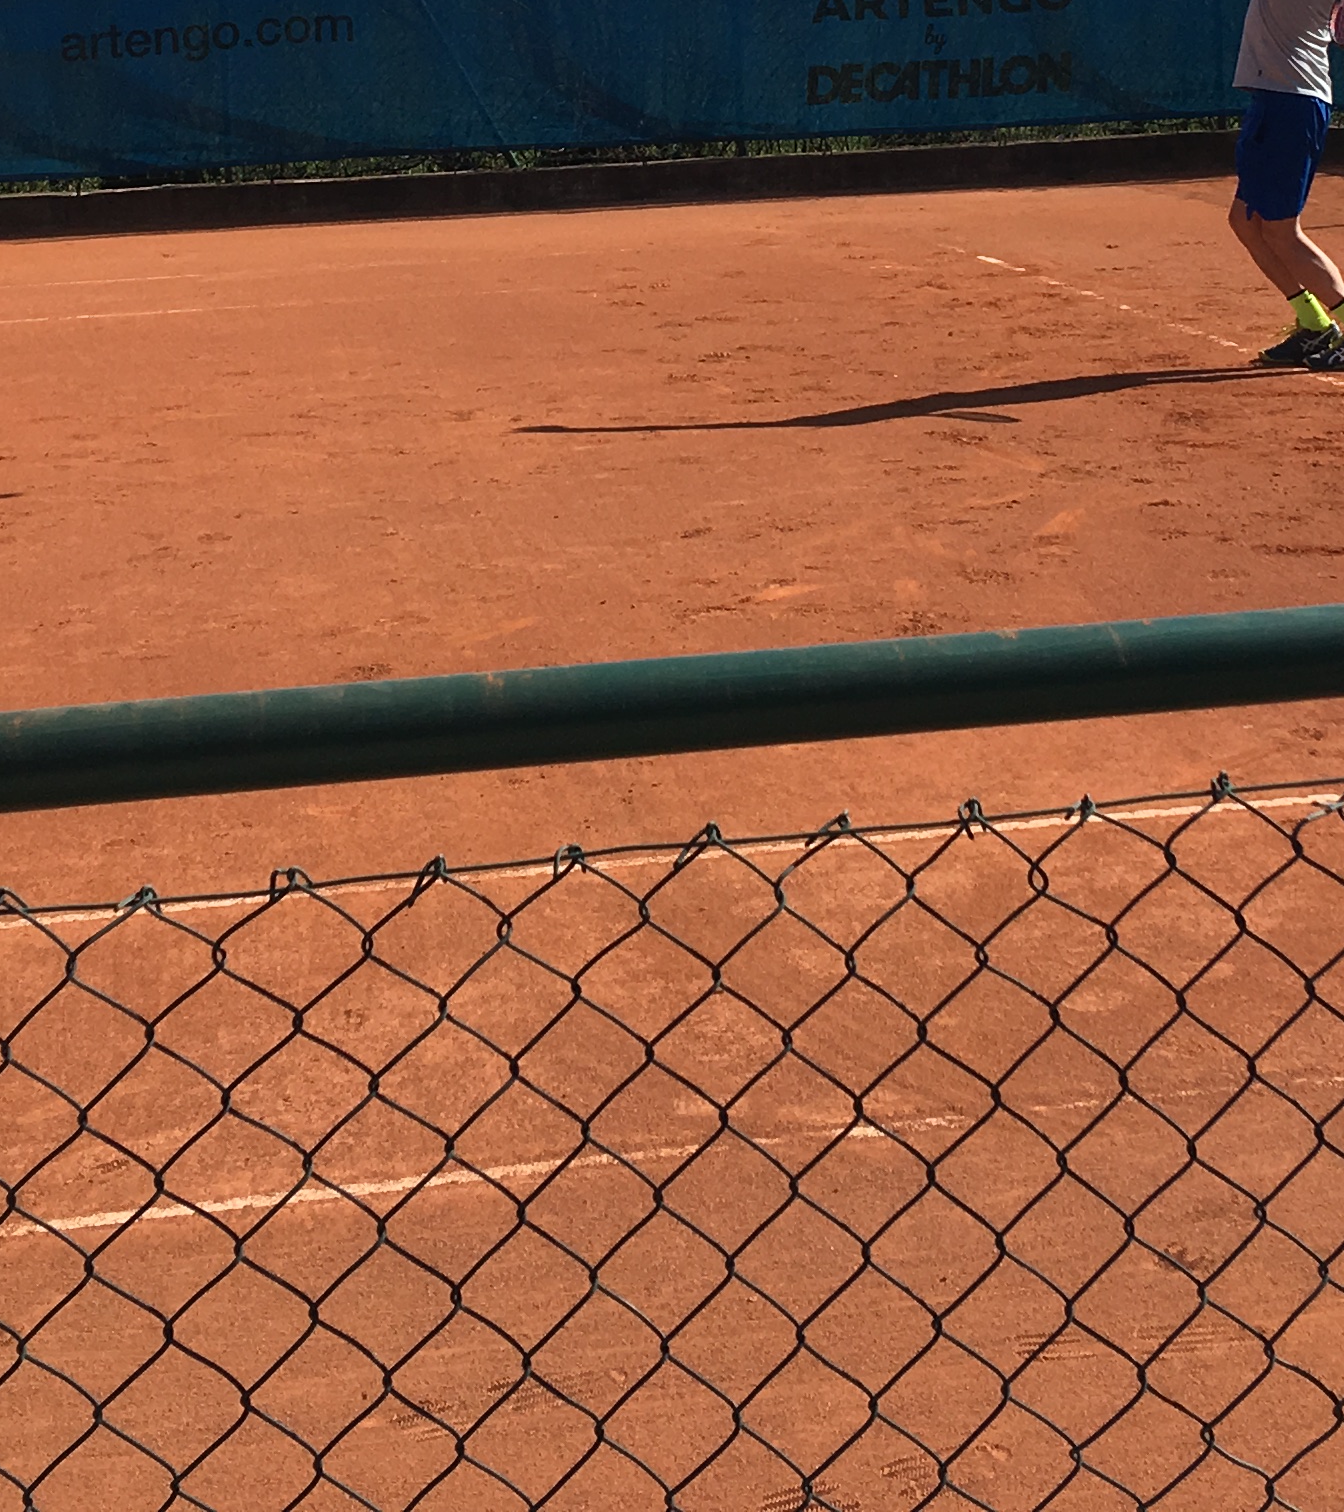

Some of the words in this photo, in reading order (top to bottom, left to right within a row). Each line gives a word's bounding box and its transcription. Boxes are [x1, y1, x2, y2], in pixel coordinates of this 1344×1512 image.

[60, 13, 354, 62] artengo.com
[924, 23, 947, 55] by
[806, 51, 1074, 106] DECATHLON
